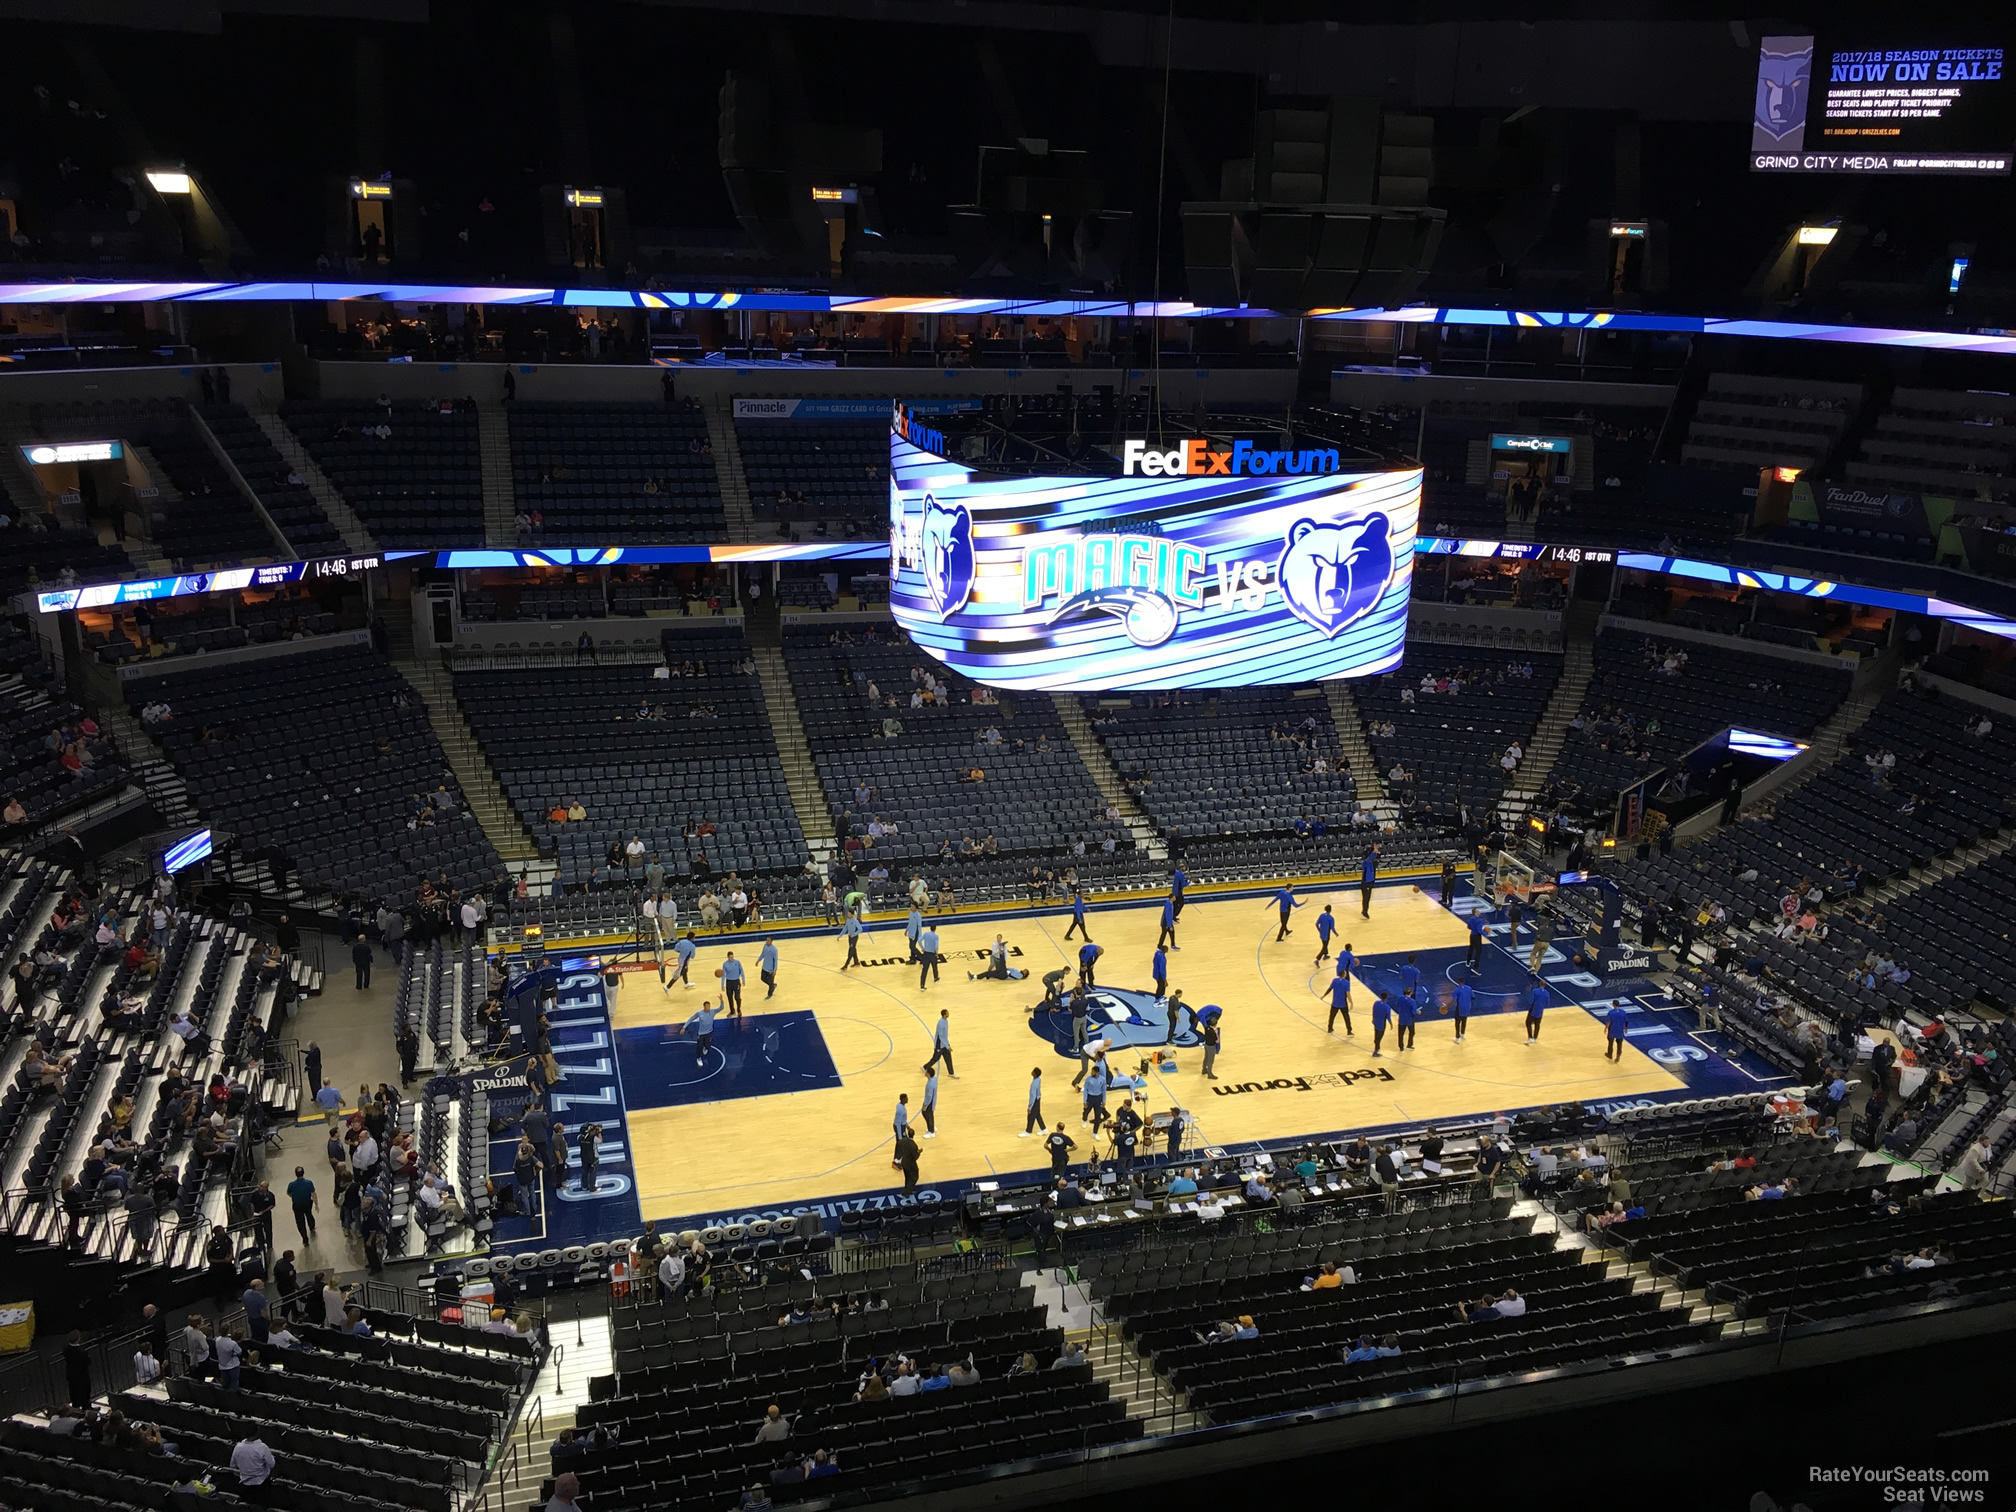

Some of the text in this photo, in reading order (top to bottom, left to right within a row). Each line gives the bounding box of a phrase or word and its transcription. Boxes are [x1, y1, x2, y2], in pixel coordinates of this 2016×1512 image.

[1832, 48, 2004, 64] 2017/18 SEASON TICKETS
[1830, 61, 2003, 82] NOW ON SALE
[1828, 88, 1961, 98] GUARANTEE LOWEST PRICES, BIGGEST GAMES,
[1827, 98, 1952, 108] BEST SEATS AND PLAYOFF TICKET PRIORITY.
[1826, 109, 1848, 118] SEASON
[1849, 109, 1873, 118] TICKETS
[1873, 109, 1892, 117] START
[1891, 109, 1900, 117] AT
[1909, 109, 1922, 117] PER
[1922, 109, 1942, 117] GAME.
[1861, 128, 1901, 136] GRIZZLIES.COM
[1755, 156, 1799, 169] GRIND
[1803, 156, 1838, 169] CITY
[1842, 156, 1888, 169] MEDIA
[1893, 159, 1917, 168] FOLLOW
[739, 401, 786, 413] Pinnacle
[831, 404, 850, 413] GRIZZ
[851, 404, 868, 412] CARD
[1123, 439, 1339, 475] FedExForum
[1827, 488, 1889, 506] FanDuel
[1552, 547, 1581, 563] 14:46
[1597, 553, 1612, 562] QTR
[258, 566, 288, 577] TIMEOUTS:
[316, 558, 347, 579] 14:46
[364, 557, 379, 569] QTR
[1022, 536, 1268, 612] MAGIC VS
[258, 575, 278, 585] FOULS:
[1608, 957, 1649, 972] SPALDING
[1212, 1067, 1396, 1096] FedExForum
[755, 1223, 767, 1235] G
[780, 1219, 792, 1231] G
[706, 1229, 718, 1240] G
[729, 1226, 741, 1238] G
[591, 1247, 603, 1256] G
[614, 1244, 627, 1253] G
[544, 1253, 556, 1263] G
[567, 1250, 579, 1260] G
[471, 1263, 484, 1272] G
[495, 1260, 507, 1269] G
[520, 1257, 532, 1267] G
